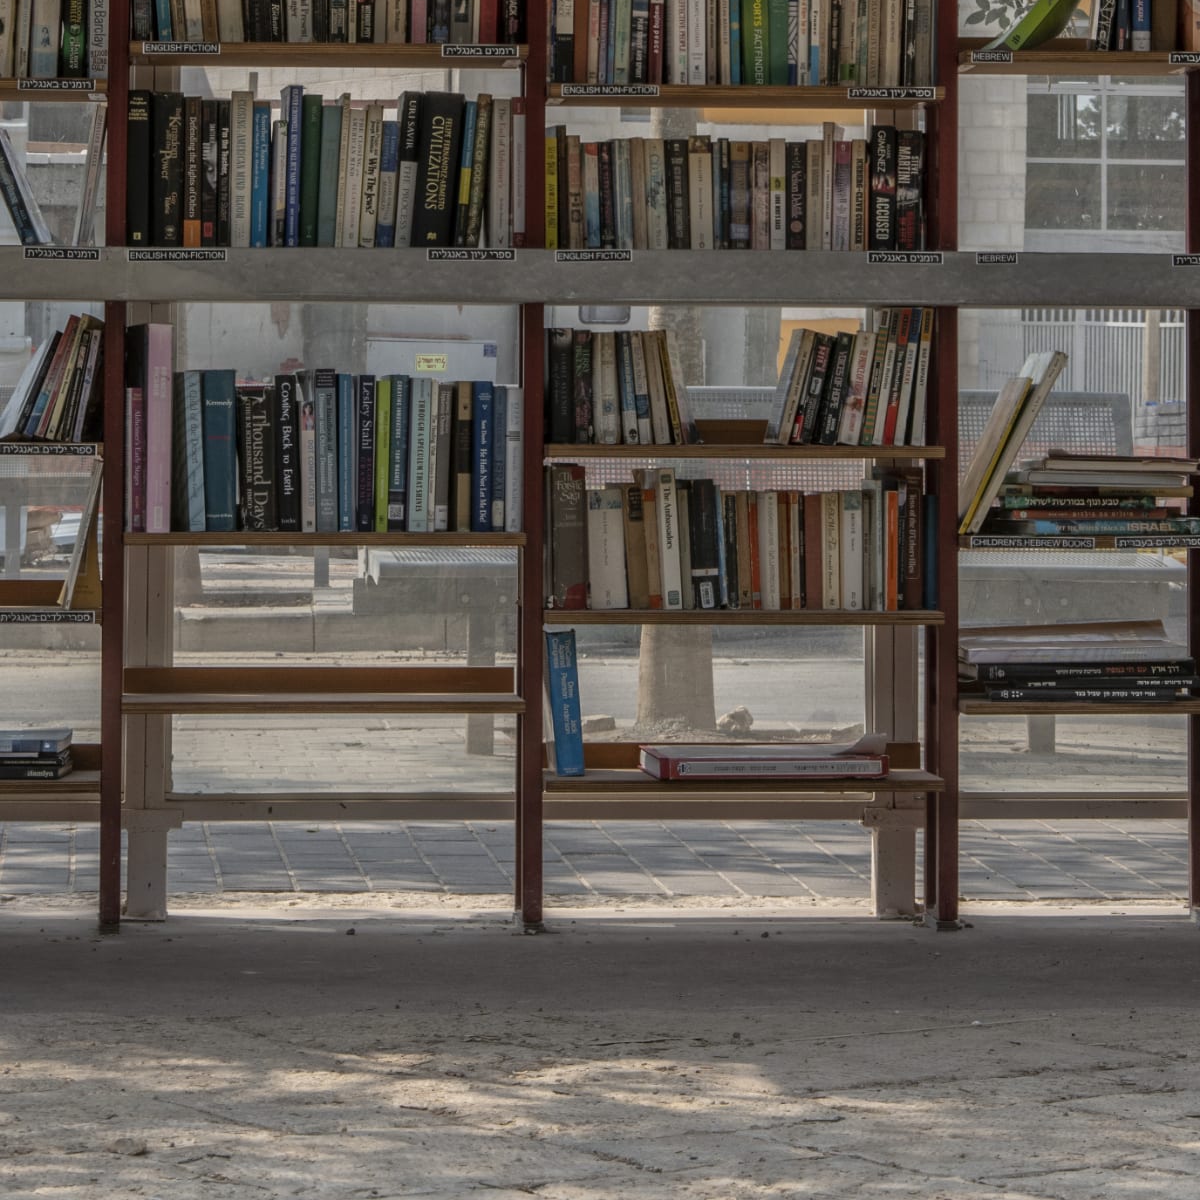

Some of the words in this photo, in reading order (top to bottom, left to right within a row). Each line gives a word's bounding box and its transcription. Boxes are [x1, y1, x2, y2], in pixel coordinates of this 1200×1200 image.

[93, 11, 107, 47] Barclay
[145, 44, 182, 52] ENGLISH
[183, 44, 217, 52] FICTION
[446, 46, 483, 55] באנגלית
[485, 46, 517, 55] רומנים
[754, 29, 763, 85] FACTFINDER
[973, 53, 1010, 62] HEBREW
[1172, 53, 1200, 62] עברית
[21, 80, 59, 88] באנגלית
[61, 80, 91, 88] רומנים
[852, 89, 888, 97] באנגלית
[891, 89, 906, 97] עיון
[909, 89, 932, 97] ספרי
[407, 100, 416, 119] URI
[169, 116, 181, 158] Kingdom
[189, 116, 197, 152] Defending
[405, 122, 415, 149] SAVIR
[877, 130, 886, 173] GIMENEZ
[189, 153, 197, 163] the
[425, 116, 444, 210] CIVILIZATIONS
[160, 150, 172, 180] Power
[367, 158, 378, 175] Why
[898, 146, 910, 184] MARTINI
[188, 164, 197, 186] Rights
[403, 165, 412, 185] THE
[367, 177, 377, 192] The
[189, 187, 197, 195] of
[189, 196, 197, 218] Others
[365, 193, 376, 214] Jews?
[400, 188, 411, 229] PROCESS
[876, 197, 889, 240] ACCUSED
[27, 249, 64, 259] באנגלית
[67, 249, 97, 259] רומנים
[130, 251, 167, 260] ENGLISH
[168, 251, 226, 260] NON-FICTION
[431, 249, 468, 259] באנגלית
[470, 249, 487, 259] עיון
[489, 249, 515, 259] ספרי
[557, 252, 594, 261] ENGLISH
[595, 252, 629, 261] FICTION
[871, 254, 907, 262] באנגלית
[909, 254, 939, 262] רומנים
[978, 255, 1014, 263] HEBREW
[203, 400, 232, 408] Kennedy
[360, 382, 373, 417] Lesley
[418, 400, 426, 432] THROUGH
[361, 420, 372, 449] Stahl
[2, 446, 39, 454] באנגלית
[43, 446, 67, 454] ילדים
[70, 446, 92, 454] ספרי
[252, 410, 272, 485] Thousand
[417, 439, 425, 470] SPECULUM
[664, 487, 672, 501] The
[415, 490, 423, 512] SHINES
[1025, 498, 1050, 506] ישראל
[1052, 498, 1085, 506] במורשת
[1086, 498, 1102, 507] ונוף
[1102, 498, 1119, 506] טבע
[252, 492, 269, 529] Days
[665, 503, 674, 550] Ambassadors
[1127, 523, 1176, 532] ISRAEL
[972, 538, 1023, 546] CHILDREN'S
[1024, 538, 1061, 546] HEBREW
[1118, 537, 1155, 546] בעברית
[1154, 537, 1181, 546] ילדים
[0, 613, 37, 622] באנגלית
[40, 613, 64, 622] ילדים
[70, 613, 90, 622] ספרי
